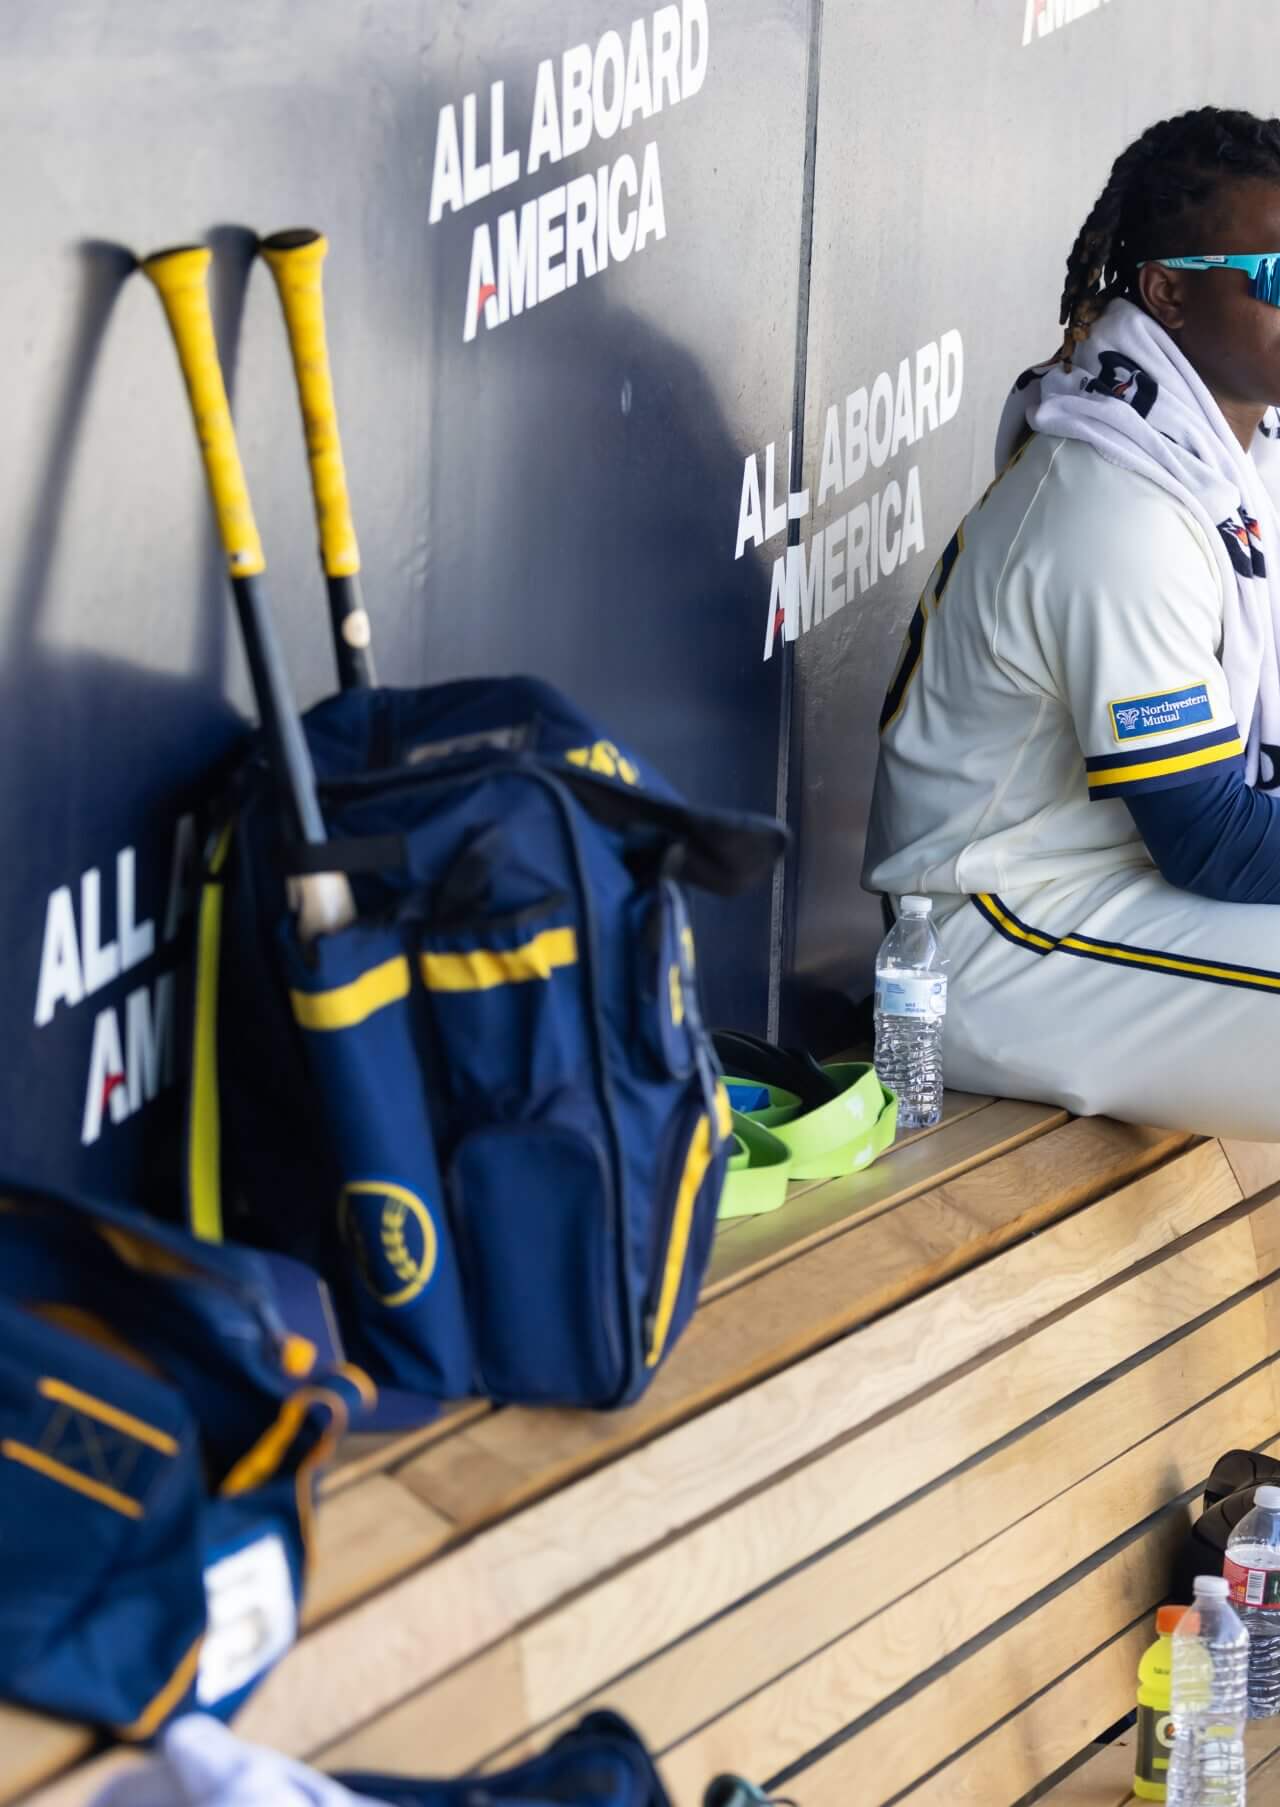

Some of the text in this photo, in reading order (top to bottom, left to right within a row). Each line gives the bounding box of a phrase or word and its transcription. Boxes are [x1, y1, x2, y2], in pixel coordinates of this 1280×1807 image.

[429, 0, 709, 224] ALL ABOARD
[463, 141, 667, 343] AMERICA
[734, 328, 963, 560] ALL ABOARD
[763, 464, 925, 662] AMERICA
[1140, 694, 1208, 717] Northwestern
[1142, 710, 1180, 727] Mutual
[33, 845, 155, 1028] ALL
